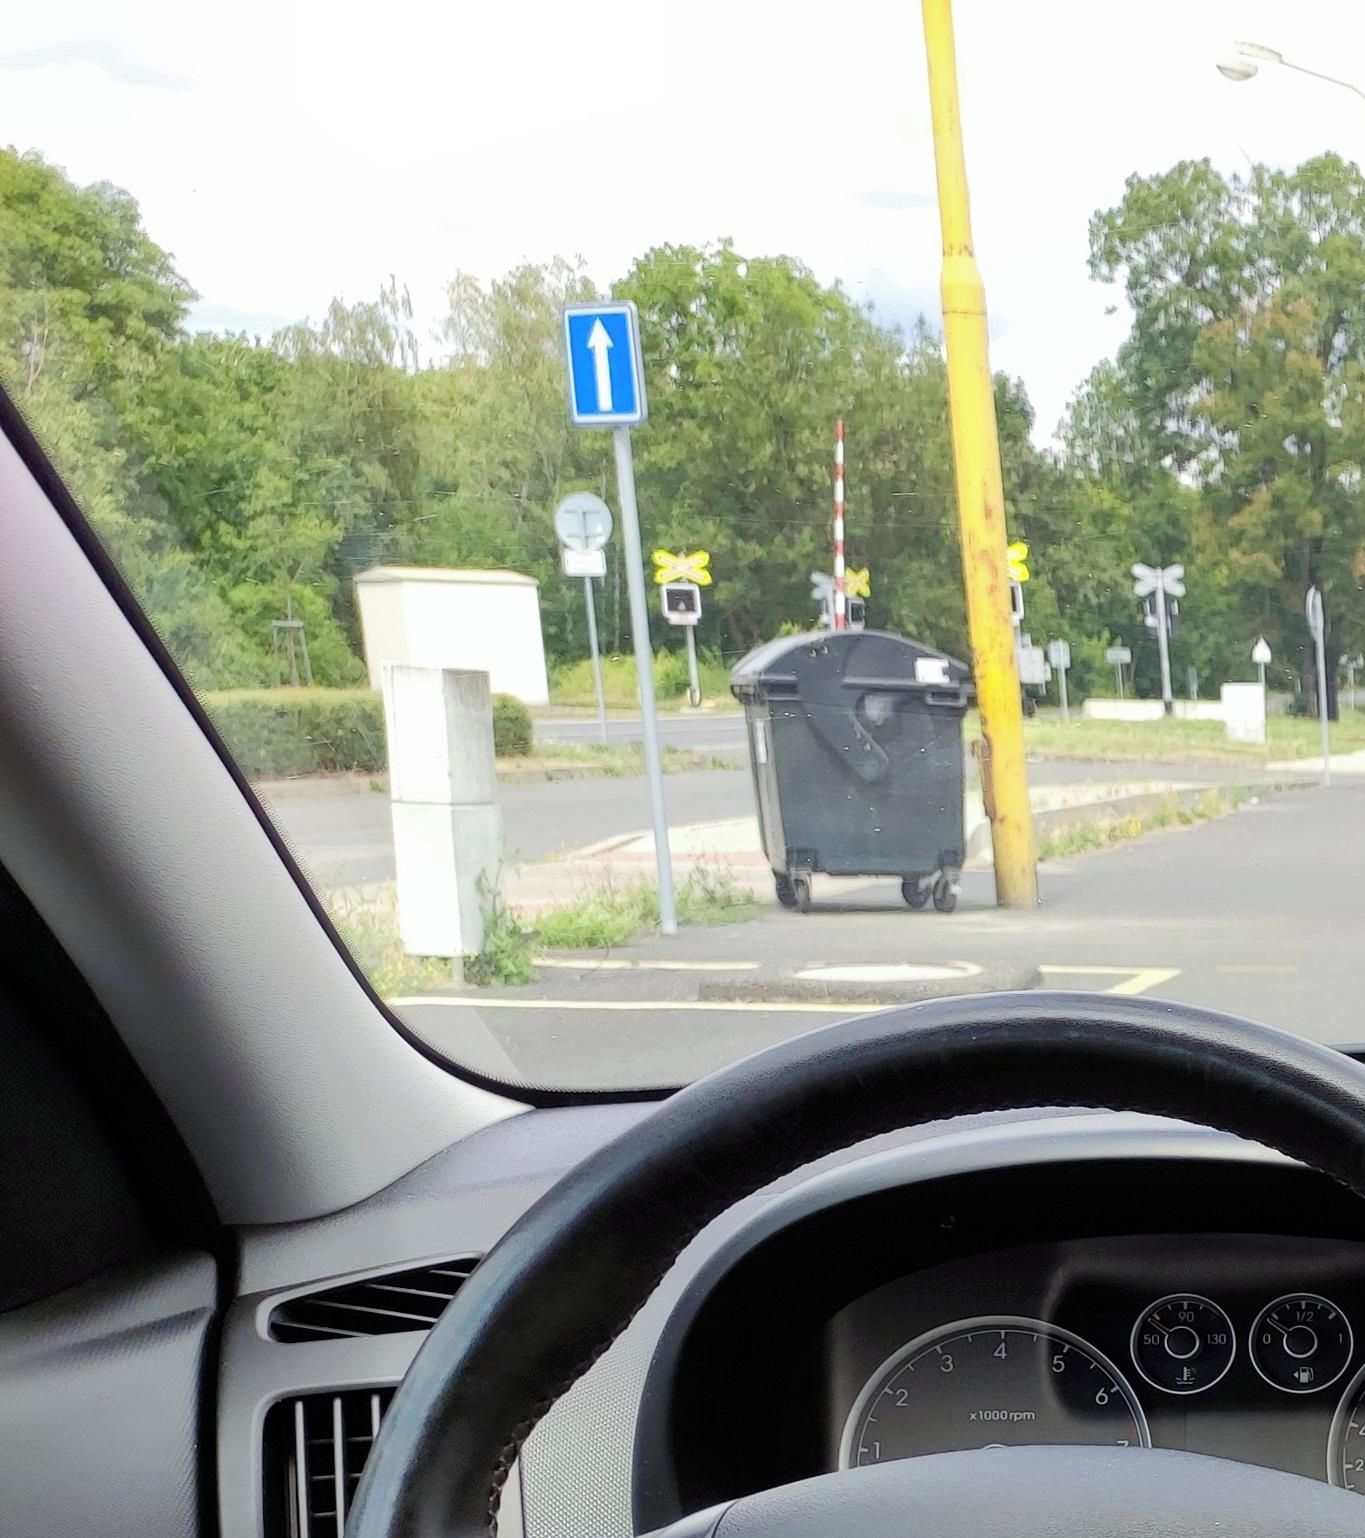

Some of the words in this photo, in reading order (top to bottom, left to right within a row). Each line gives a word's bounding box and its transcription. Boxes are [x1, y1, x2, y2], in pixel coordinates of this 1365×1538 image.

[1178, 1311, 1194, 1323] 90
[1296, 1311, 1314, 1323] 1/2
[1143, 1334, 1160, 1345] 50
[1207, 1334, 1226, 1345] 130
[1262, 1334, 1271, 1345] 0
[993, 1342, 1007, 1360] 4
[940, 1355, 953, 1372] 3
[1052, 1355, 1065, 1373] 5
[895, 1389, 909, 1407] 2
[1095, 1386, 1109, 1405] 6
[1009, 1411, 1035, 1423] rpm
[873, 1442, 880, 1459] 1
